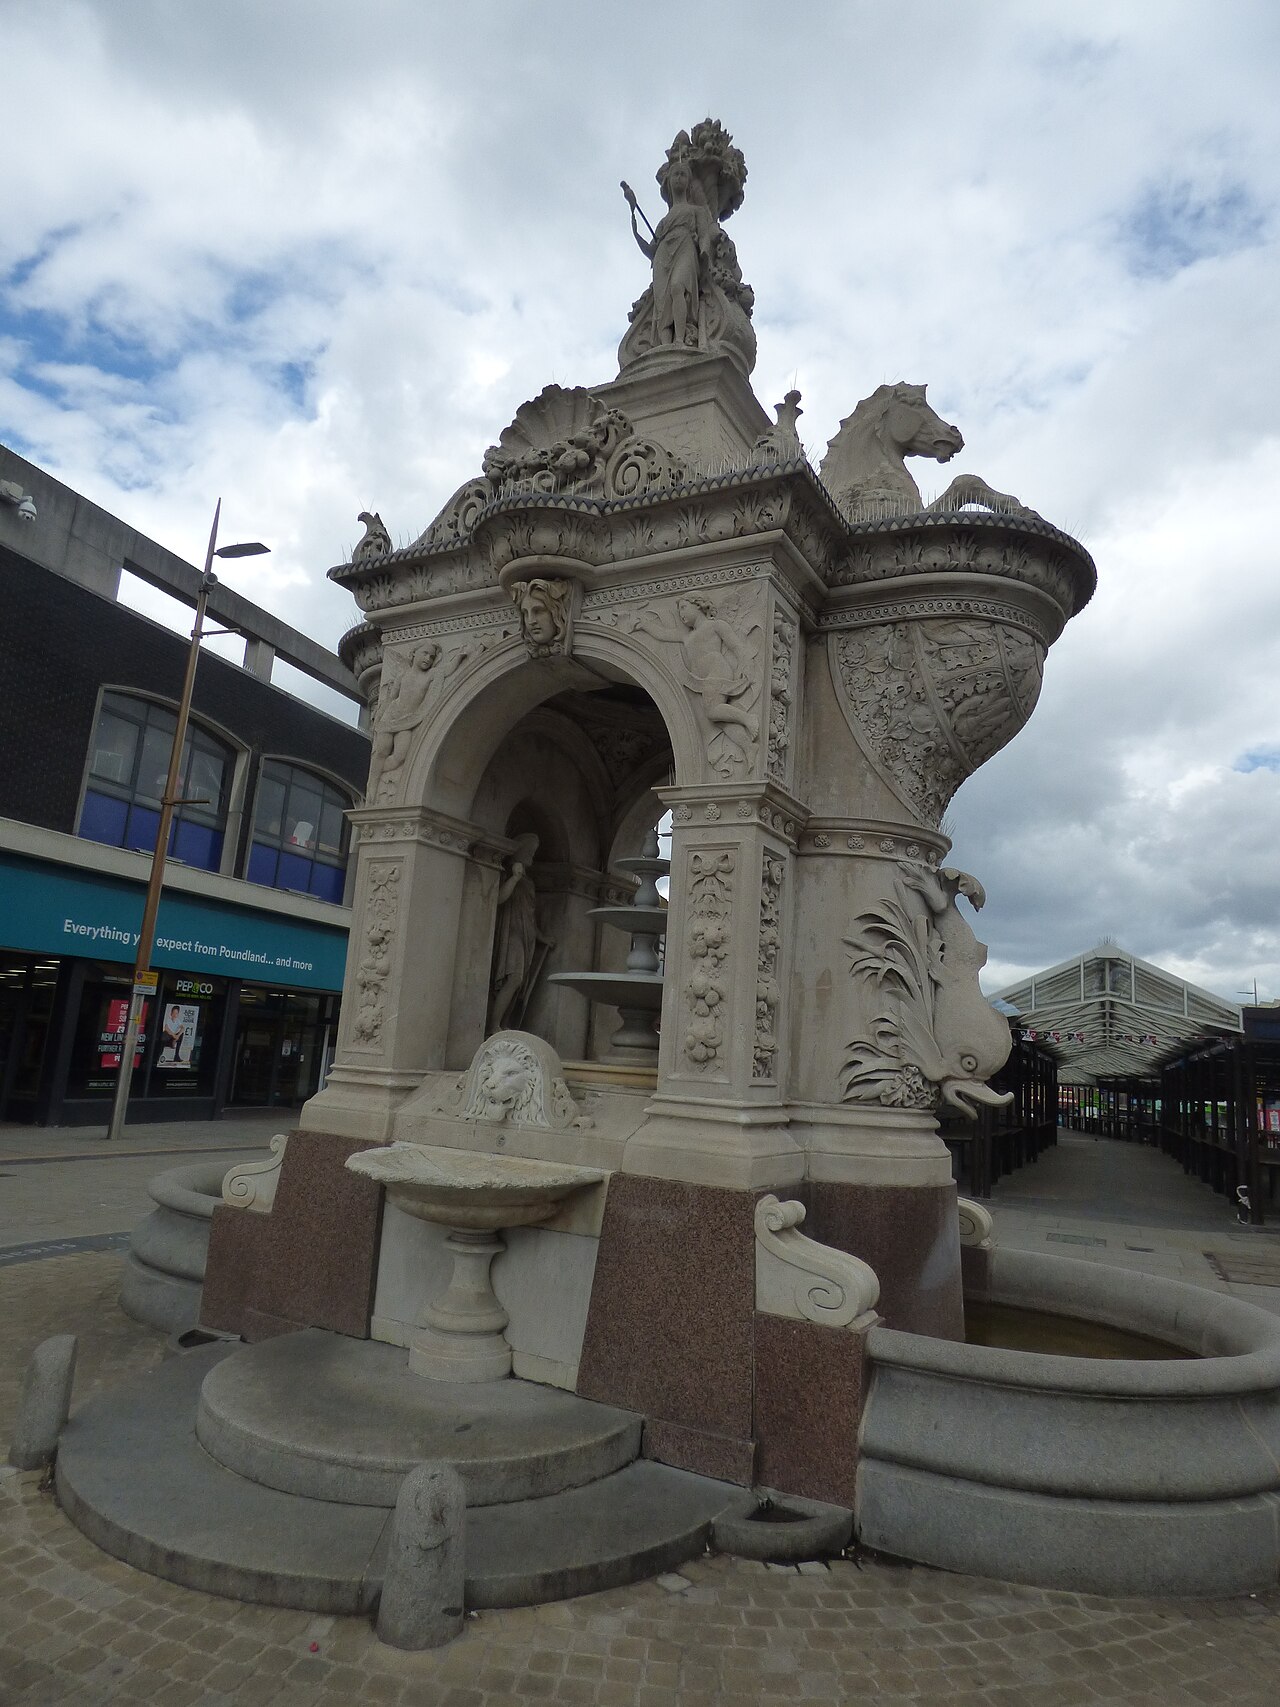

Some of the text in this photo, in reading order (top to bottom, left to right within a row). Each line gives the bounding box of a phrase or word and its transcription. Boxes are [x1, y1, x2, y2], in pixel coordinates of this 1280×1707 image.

[63, 919, 131, 945] Everything
[156, 937, 192, 952] expect
[194, 941, 217, 956] from
[219, 945, 274, 965] Poundland...
[275, 956, 291, 968] and
[292, 960, 313, 971] more
